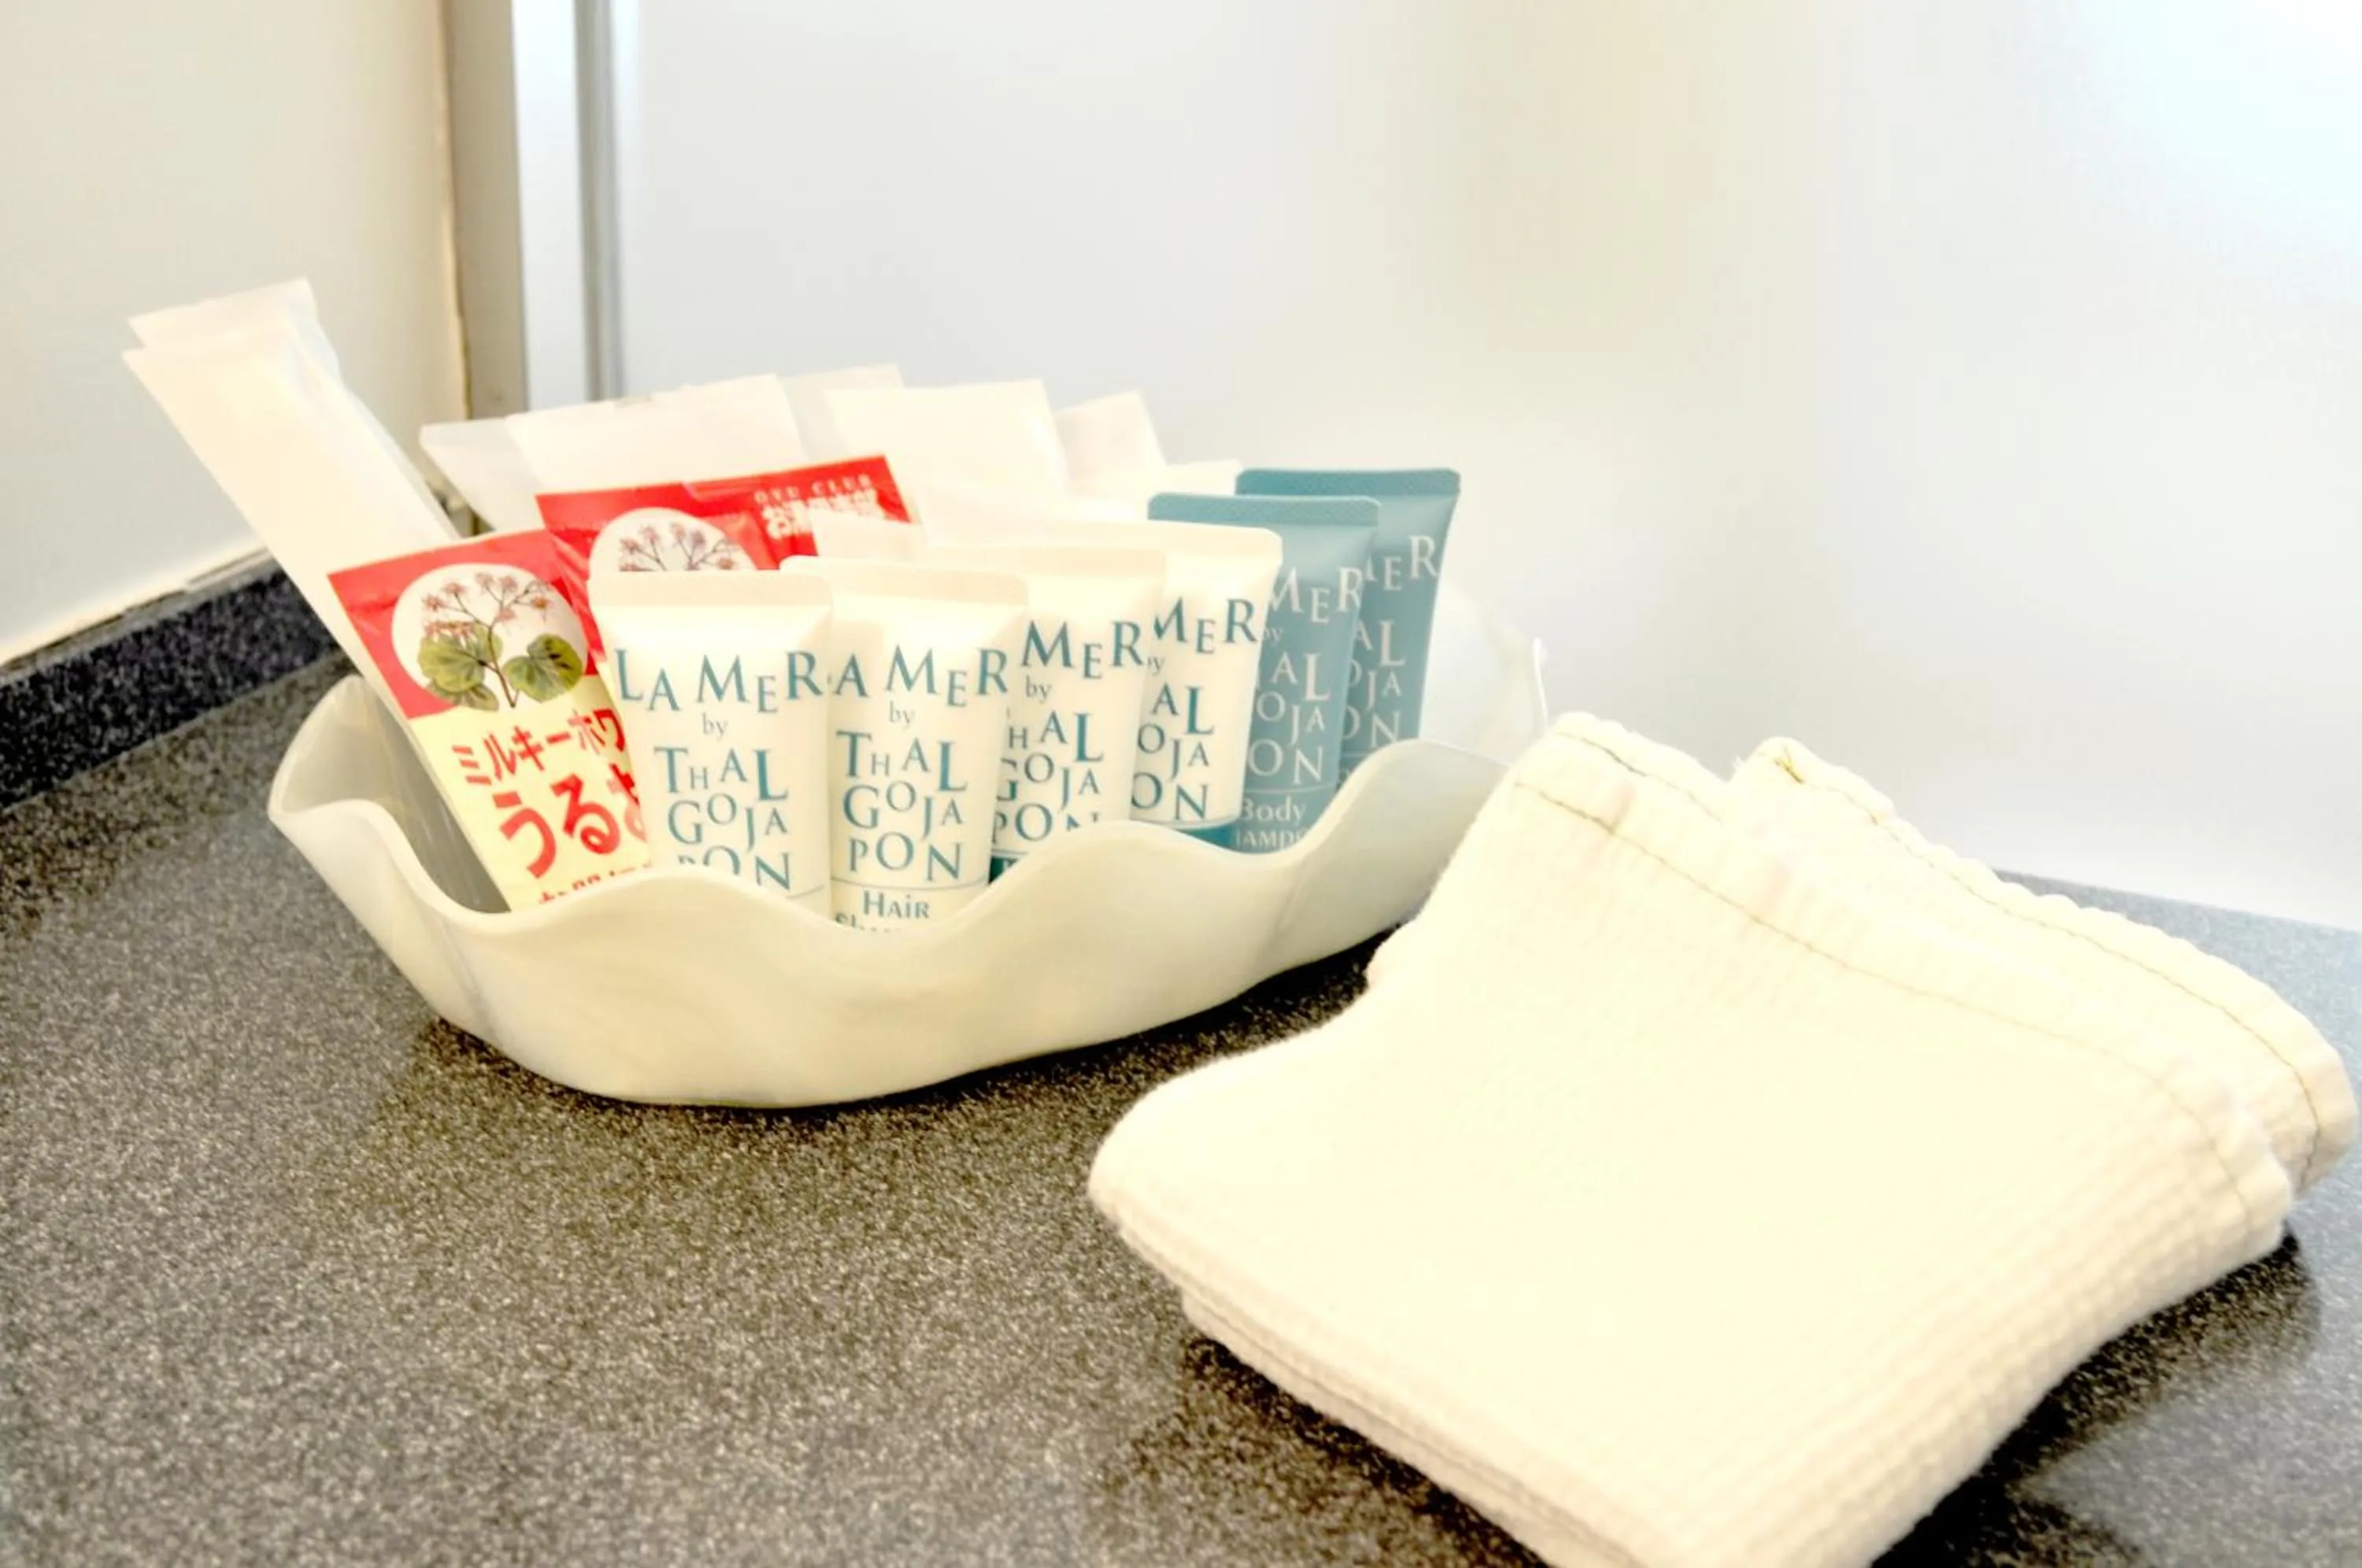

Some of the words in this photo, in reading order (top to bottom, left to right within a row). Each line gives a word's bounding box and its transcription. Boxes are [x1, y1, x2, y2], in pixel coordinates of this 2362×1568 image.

[1364, 534, 1439, 591] ER
[1021, 619, 1143, 679] MER
[1153, 596, 1257, 654] MER
[615, 649, 681, 711] LA
[696, 650, 824, 713] MER
[827, 653, 870, 699] A
[884, 645, 1009, 708] MER
[1025, 674, 1052, 704] by
[1270, 651, 1331, 701] AL
[702, 713, 728, 741] by
[889, 701, 915, 729] by
[1006, 706, 1105, 762] HAL
[1150, 682, 1214, 735] AL
[654, 746, 788, 801] THAL
[836, 730, 968, 793] THAL
[1249, 738, 1324, 786] ON
[668, 793, 787, 852] GOJA
[843, 780, 964, 841] GOJA
[848, 831, 964, 882] PON
